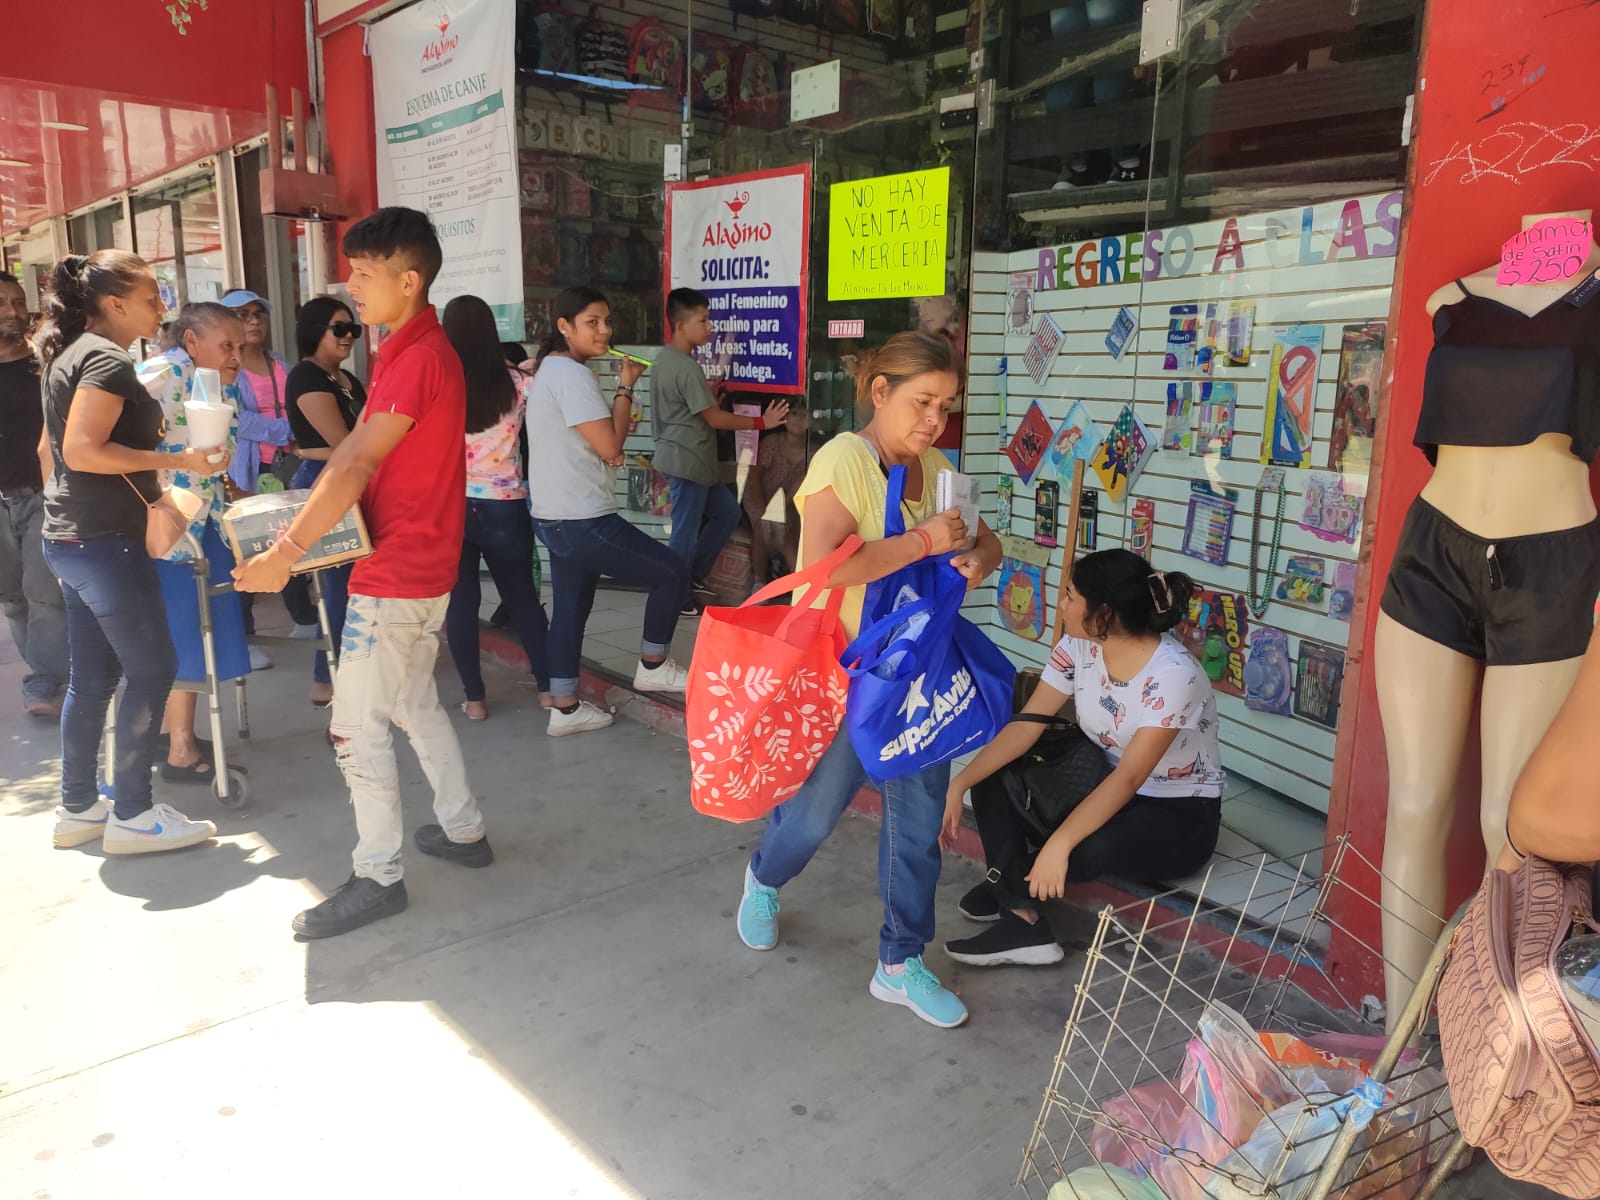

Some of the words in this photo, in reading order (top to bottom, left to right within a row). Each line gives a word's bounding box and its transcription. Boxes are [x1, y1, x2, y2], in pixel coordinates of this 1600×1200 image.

[406, 88, 442, 117] ESQUEMA
[440, 85, 455, 103] DE
[455, 72, 487, 98] CANJE
[852, 185, 874, 209] NO
[889, 176, 927, 205] HAY
[437, 218, 475, 242] QUISITOS
[844, 208, 910, 239] VENTA
[917, 203, 943, 230] DE
[702, 221, 772, 249] Aladino
[852, 239, 939, 271] MERCERIA
[1036, 225, 1194, 291] REGRESO
[1211, 217, 1246, 274] A
[1503, 248, 1524, 262] de
[701, 256, 770, 282] SOLICITA:
[731, 292, 788, 310] Femenino
[753, 323, 780, 336] para
[830, 323, 863, 337] ENTRADA
[715, 335, 748, 356] Áreas:
[749, 339, 792, 360] Ventas,
[698, 360, 722, 379] ajas
[723, 364, 731, 380] y
[732, 361, 776, 383] Bodega.
[1219, 595, 1241, 649] HERO
[1228, 652, 1243, 690] UP!
